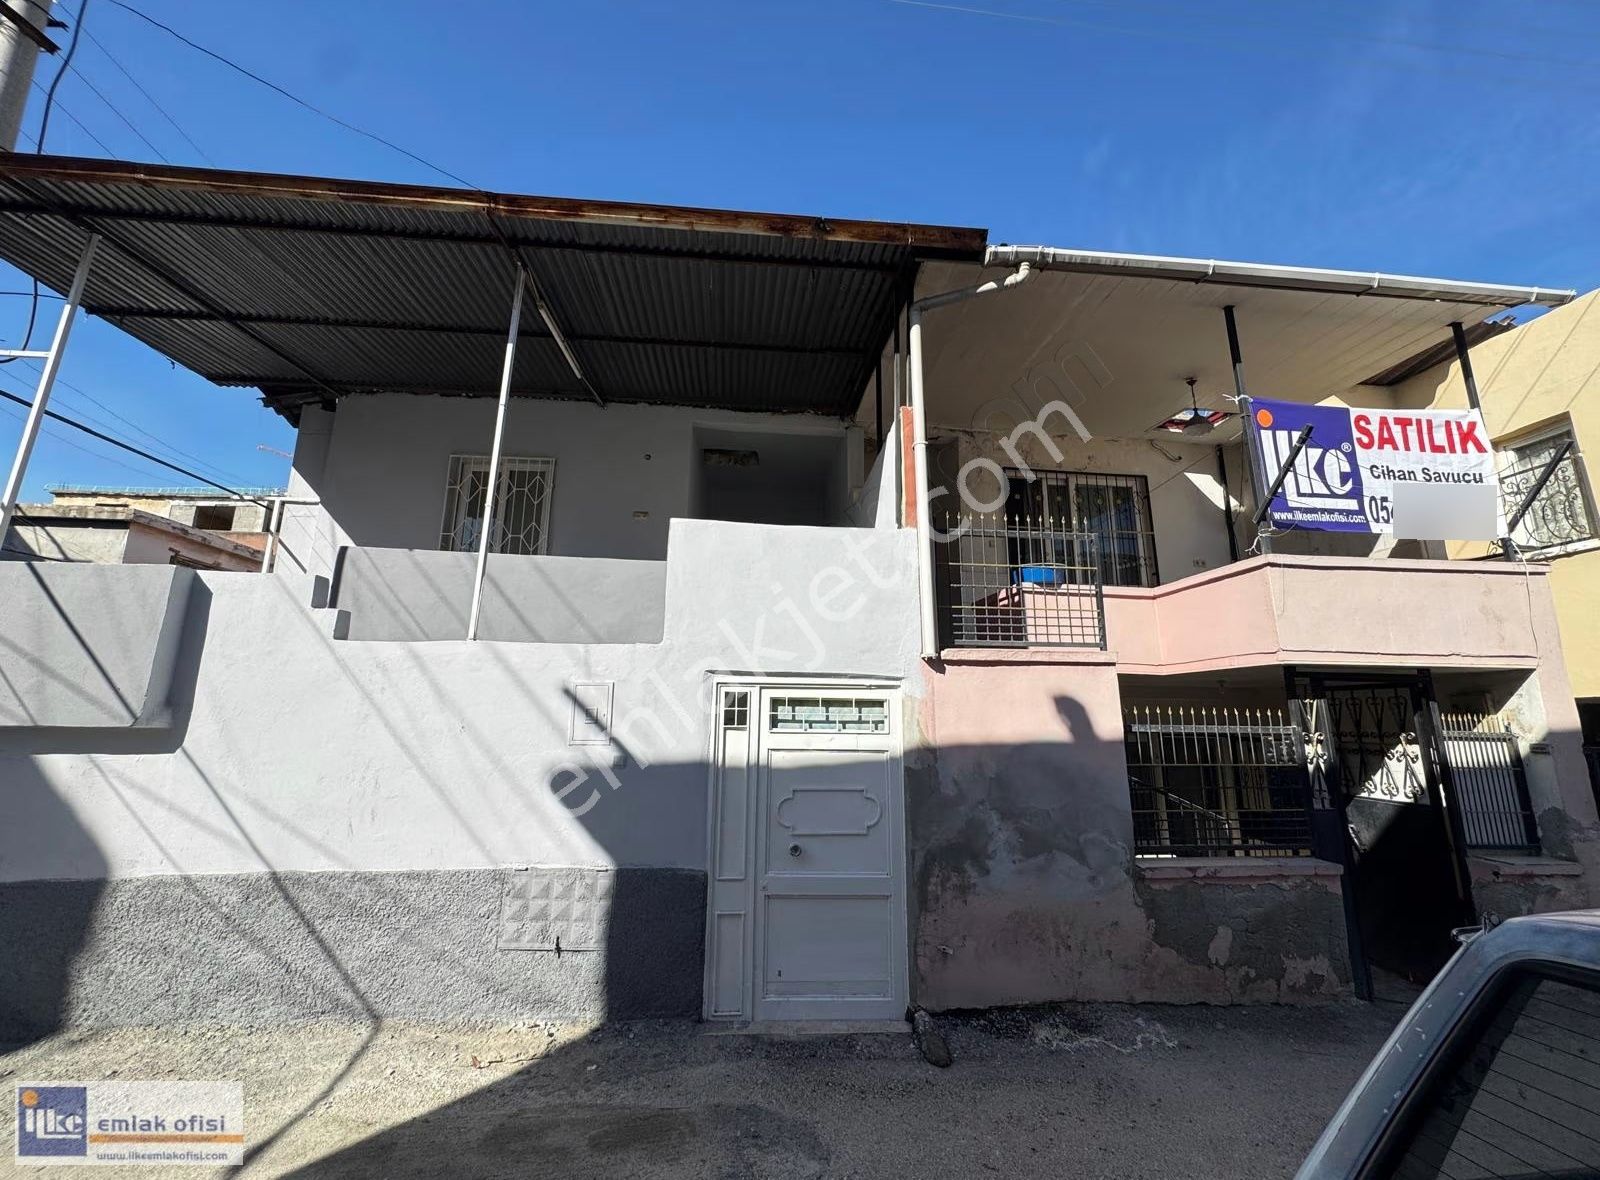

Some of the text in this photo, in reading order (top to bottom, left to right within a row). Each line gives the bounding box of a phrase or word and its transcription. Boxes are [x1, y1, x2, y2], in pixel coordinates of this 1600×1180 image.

[1353, 414, 1488, 454] SATILIK
[1369, 464, 1484, 484] Cihan Savucu
[1272, 510, 1367, 523] www.ilkeemlakofisi.com
[1368, 495, 1394, 524] 05
